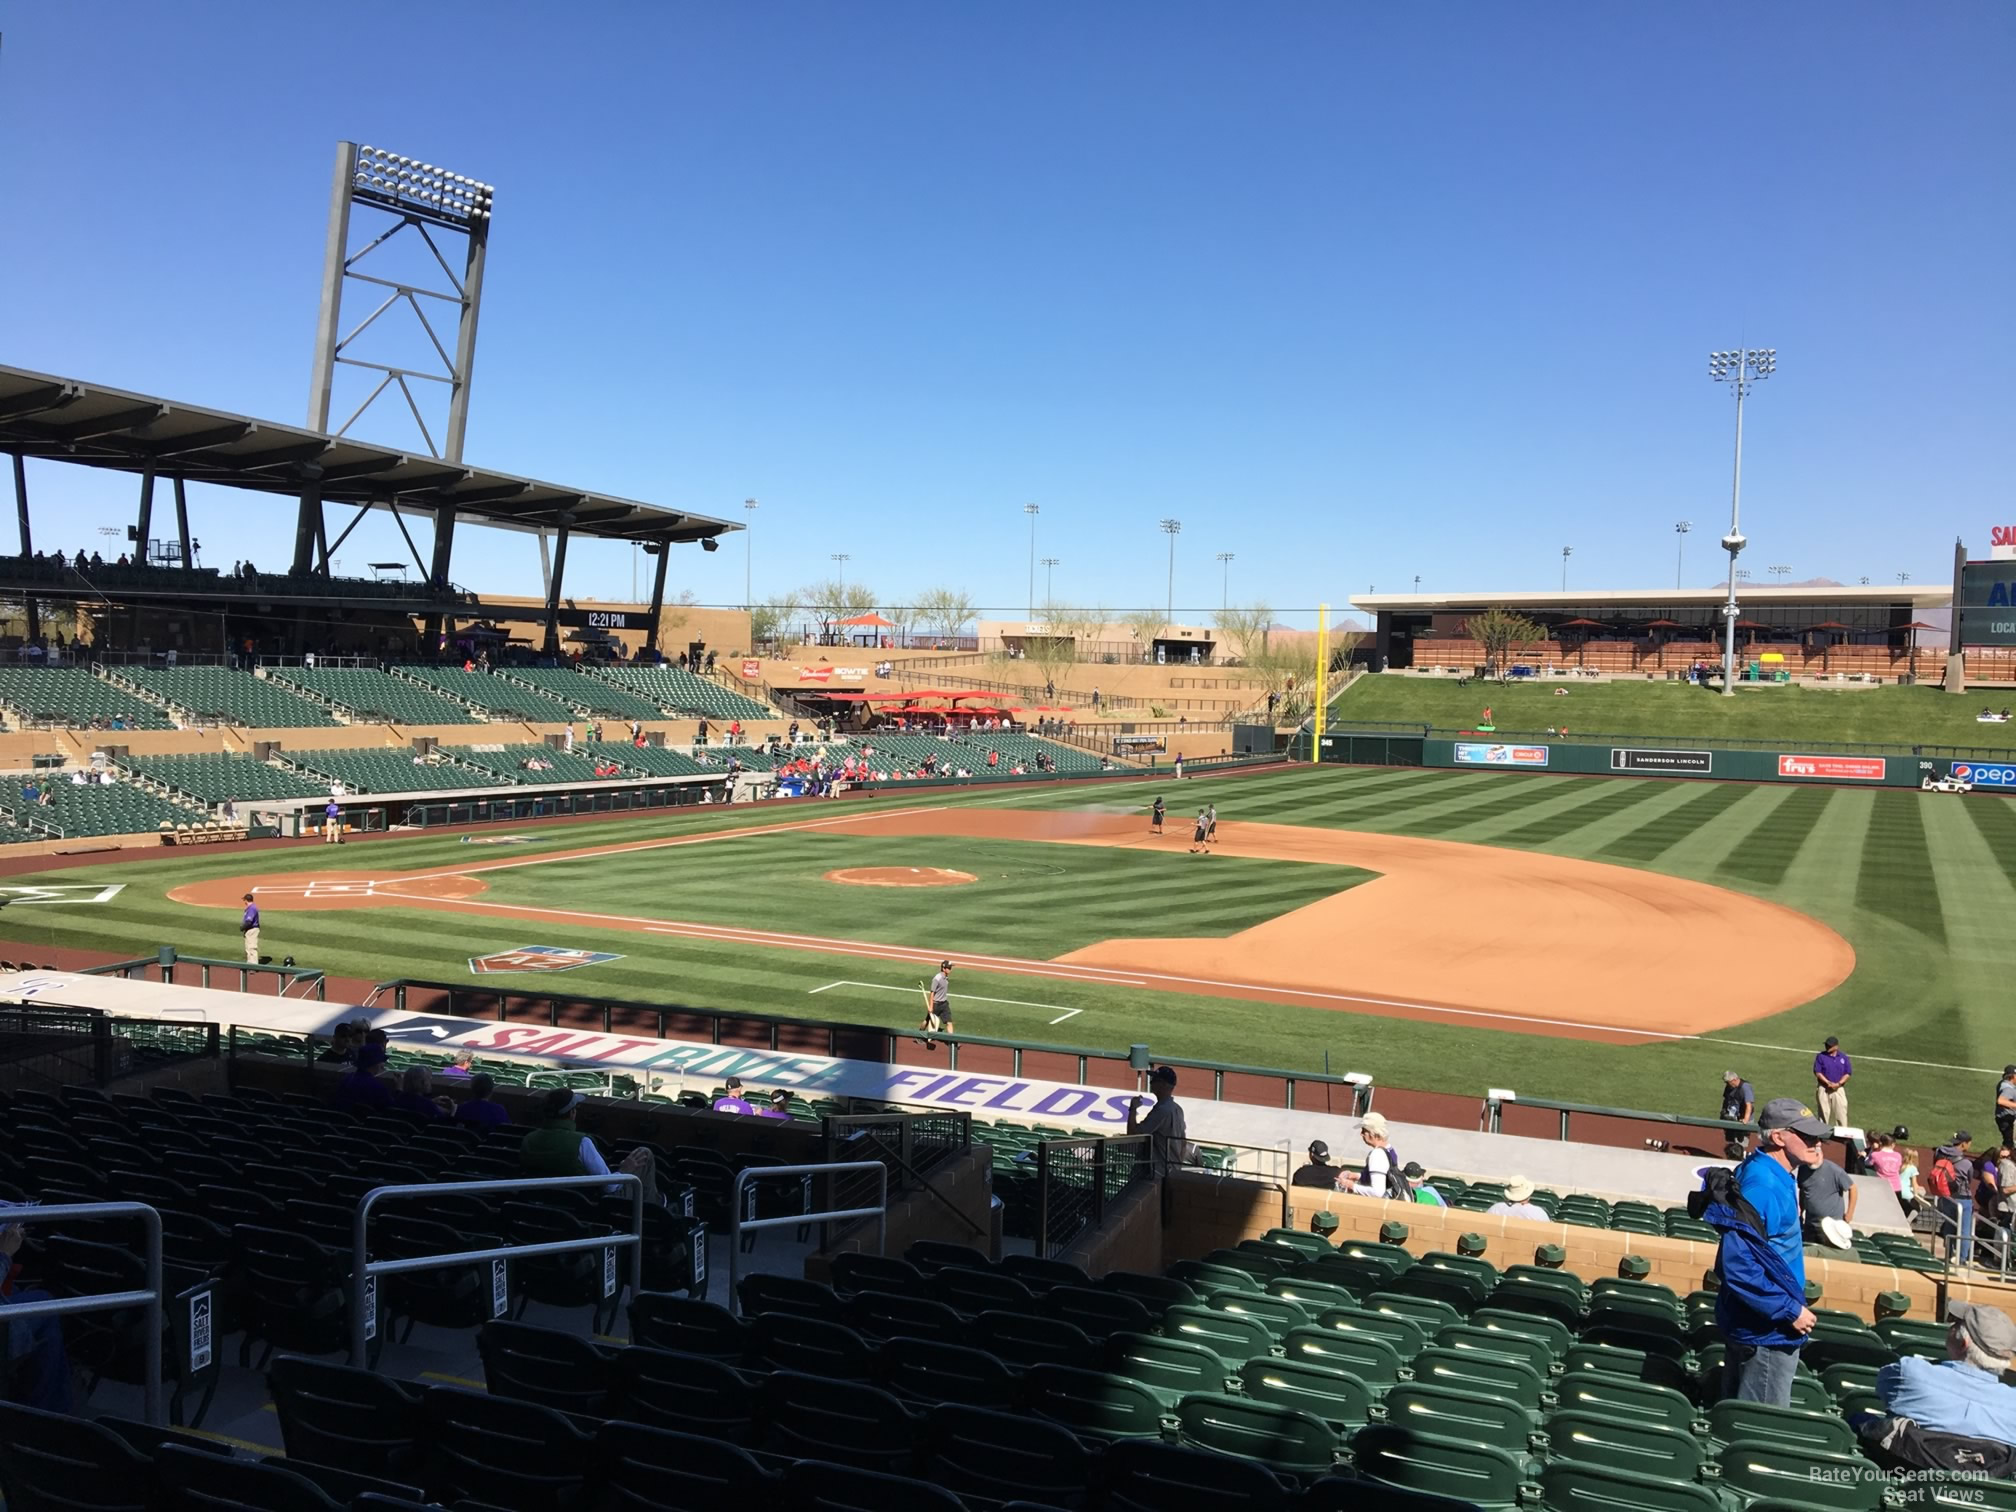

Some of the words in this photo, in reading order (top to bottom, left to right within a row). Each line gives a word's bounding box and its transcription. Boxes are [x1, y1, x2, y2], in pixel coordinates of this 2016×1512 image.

[589, 612, 609, 626] 12:21
[611, 614, 625, 627] PM
[1990, 622, 2016, 633] LOCA
[1783, 758, 1816, 774] fry's
[1920, 761, 1932, 769] 390
[462, 1028, 659, 1060] SALT
[873, 1070, 1156, 1124] FIELDS
[194, 1314, 209, 1329] SALT
